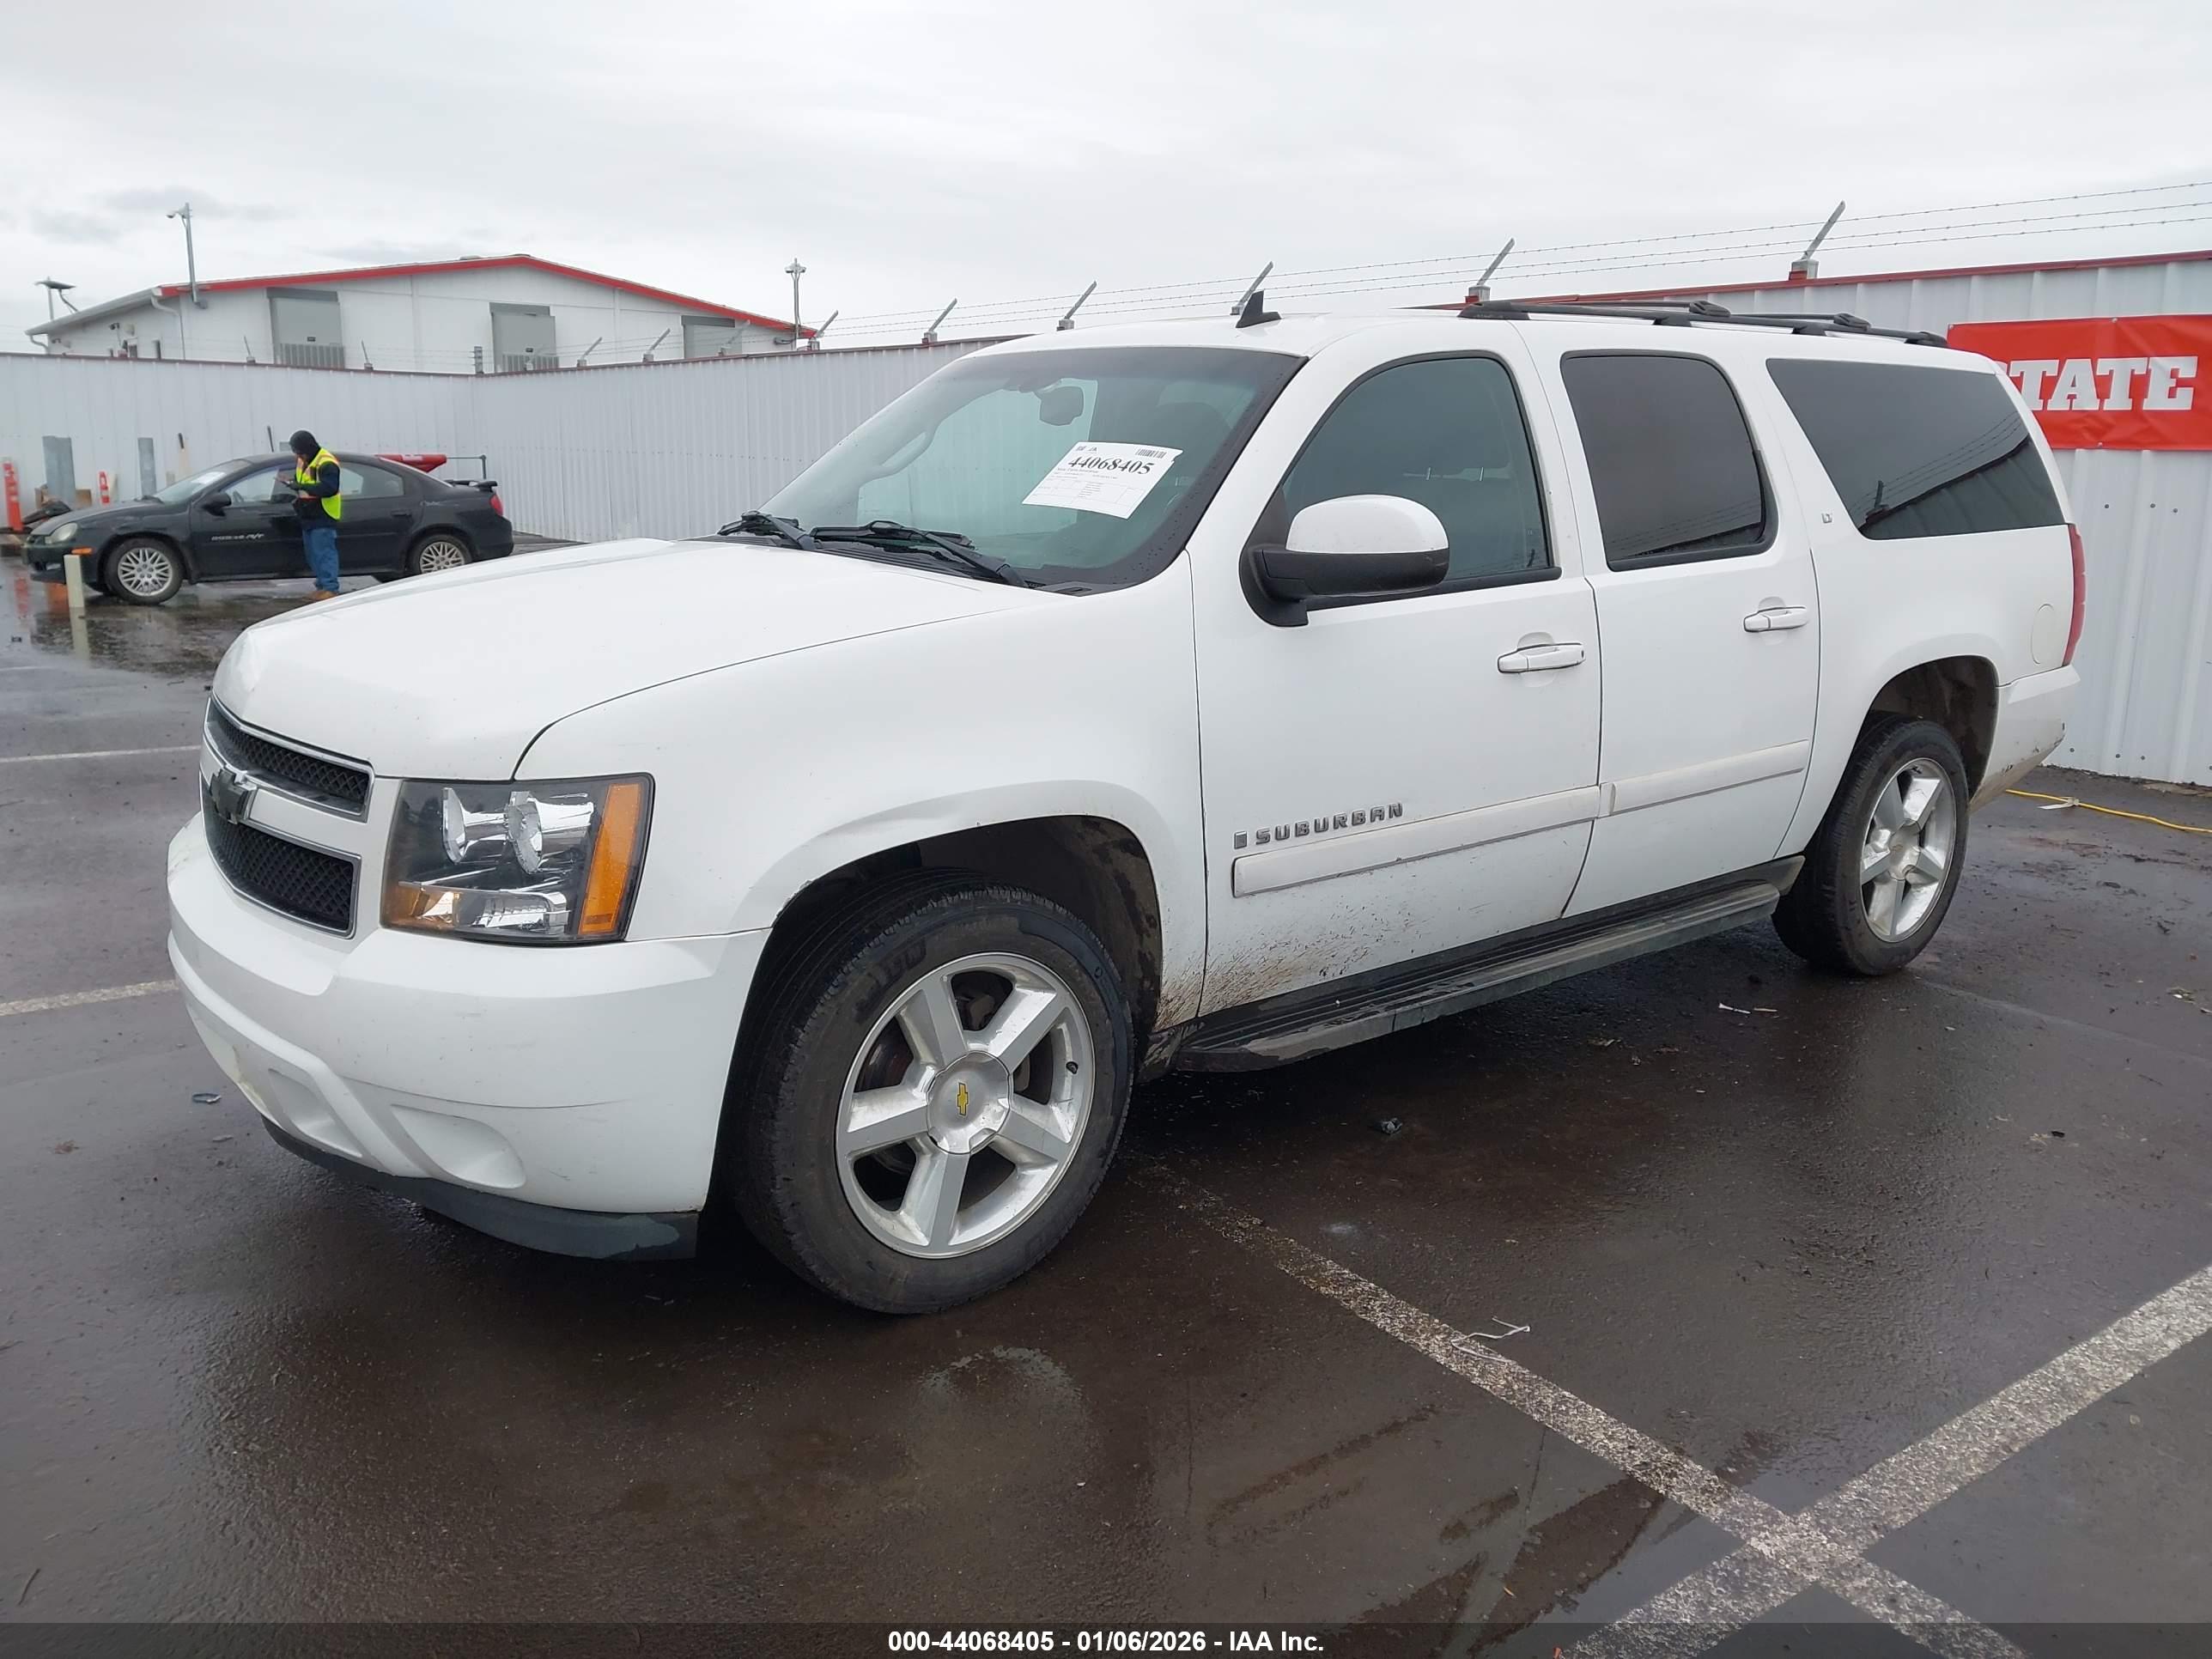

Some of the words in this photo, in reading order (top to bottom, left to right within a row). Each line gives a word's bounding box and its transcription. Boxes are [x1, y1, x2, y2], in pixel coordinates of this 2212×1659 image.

[1996, 356, 2198, 411] TATE
[1068, 456, 1155, 475] 44068405
[1255, 803, 1403, 845] SUBURBAN
